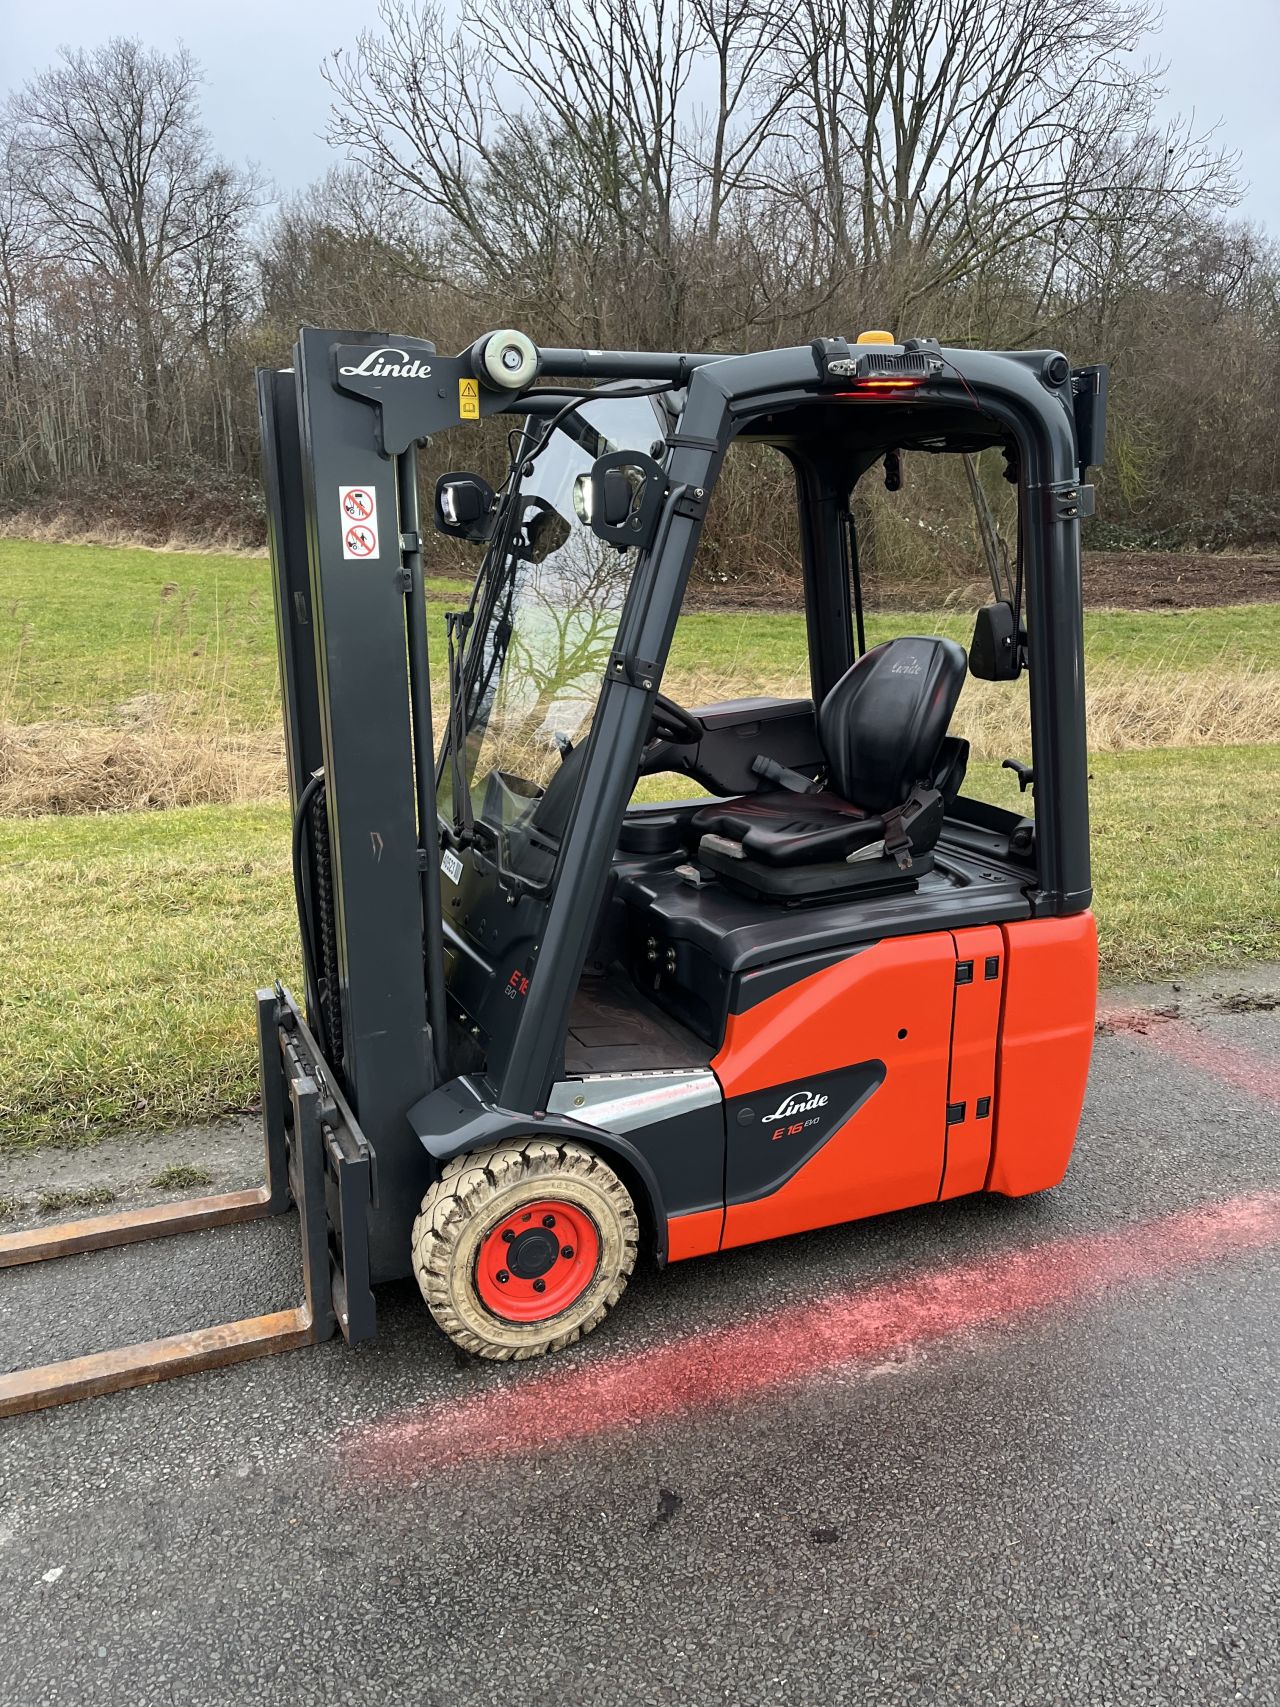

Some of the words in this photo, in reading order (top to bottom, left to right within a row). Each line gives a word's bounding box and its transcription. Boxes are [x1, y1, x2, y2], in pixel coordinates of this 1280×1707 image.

[340, 348, 432, 379] Linde
[510, 970, 521, 987] E
[761, 1091, 829, 1123] Linde
[772, 1128, 786, 1141] E
[787, 1122, 804, 1136] 16
[804, 1116, 820, 1128] EVO
